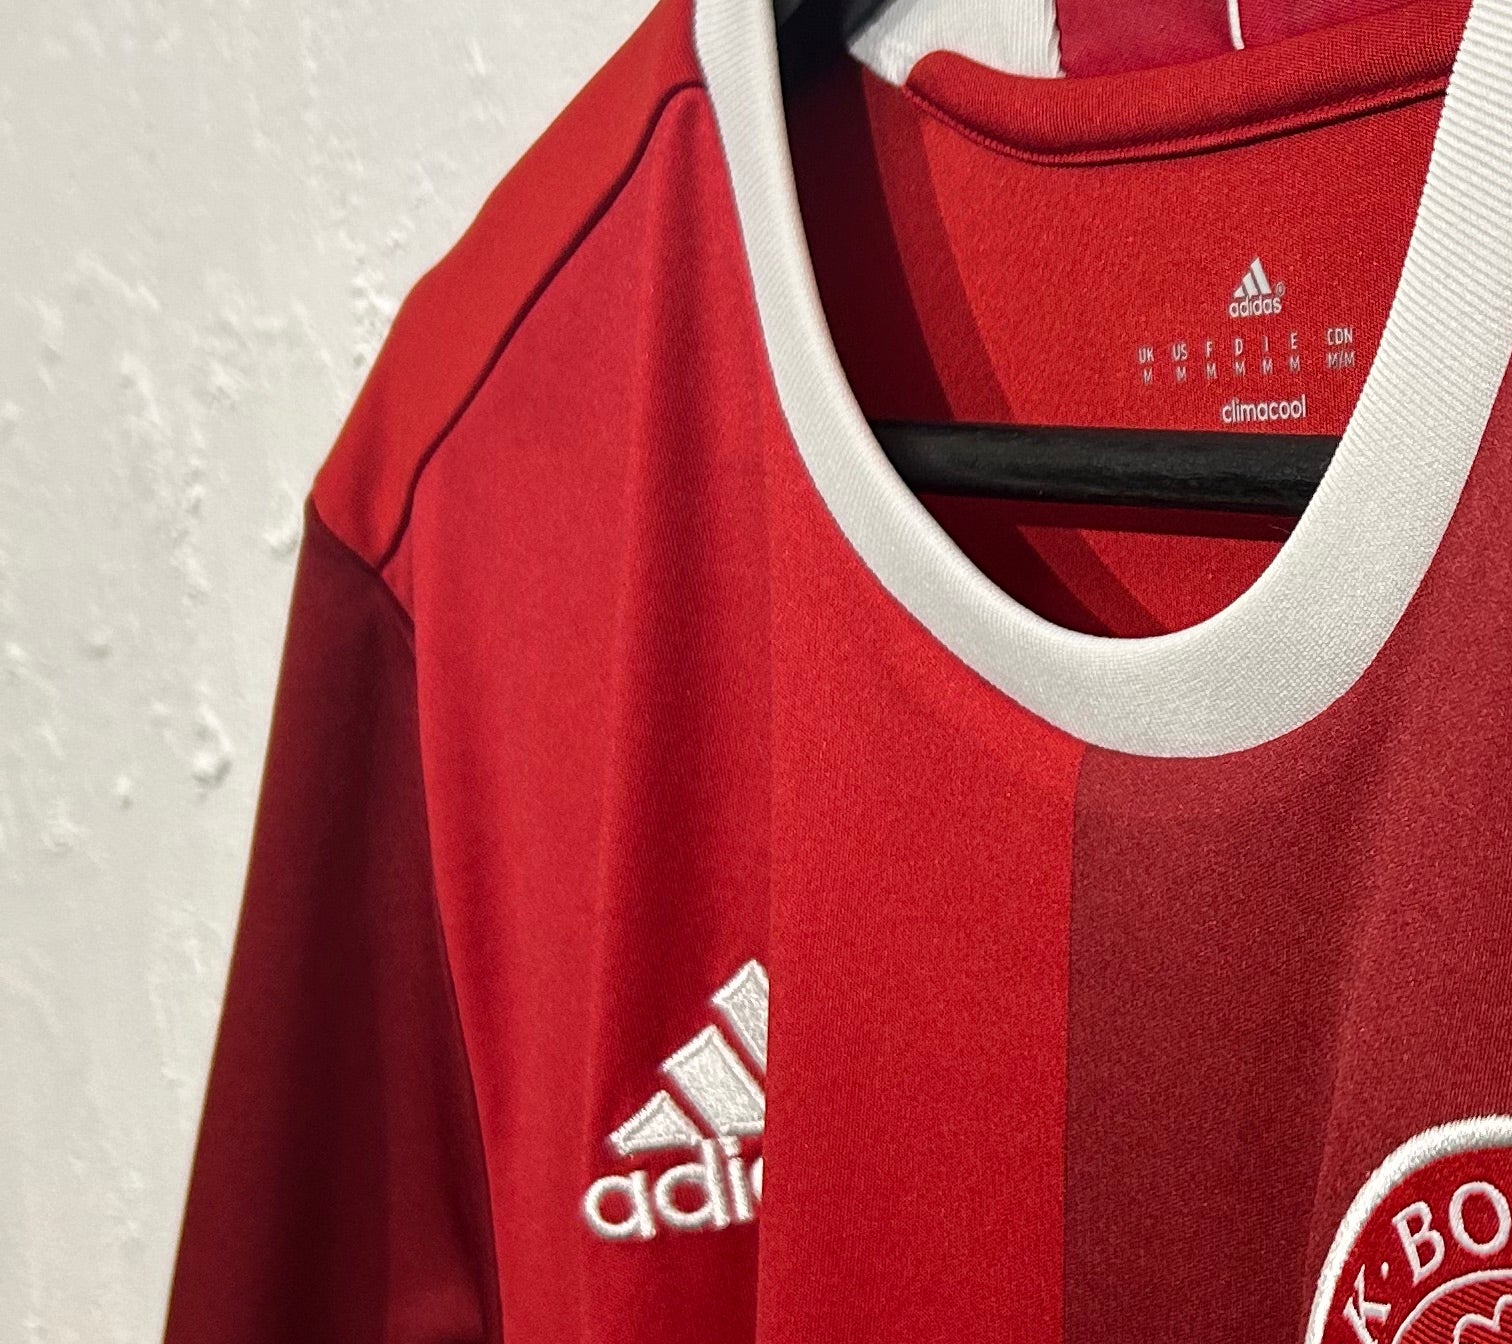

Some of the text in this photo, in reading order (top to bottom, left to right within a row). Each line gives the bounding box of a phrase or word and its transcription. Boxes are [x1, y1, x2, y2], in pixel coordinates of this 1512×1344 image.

[1229, 294, 1282, 319] adidas
[1138, 346, 1154, 365] UK
[1172, 342, 1188, 362] US
[1206, 341, 1214, 357] F
[1234, 338, 1243, 355] D
[1290, 332, 1298, 350] E
[1327, 327, 1353, 346] CDN
[1142, 350, 1355, 384] M M M M M M M/M
[1221, 394, 1306, 424] climacool
[583, 1135, 764, 1241] adi
